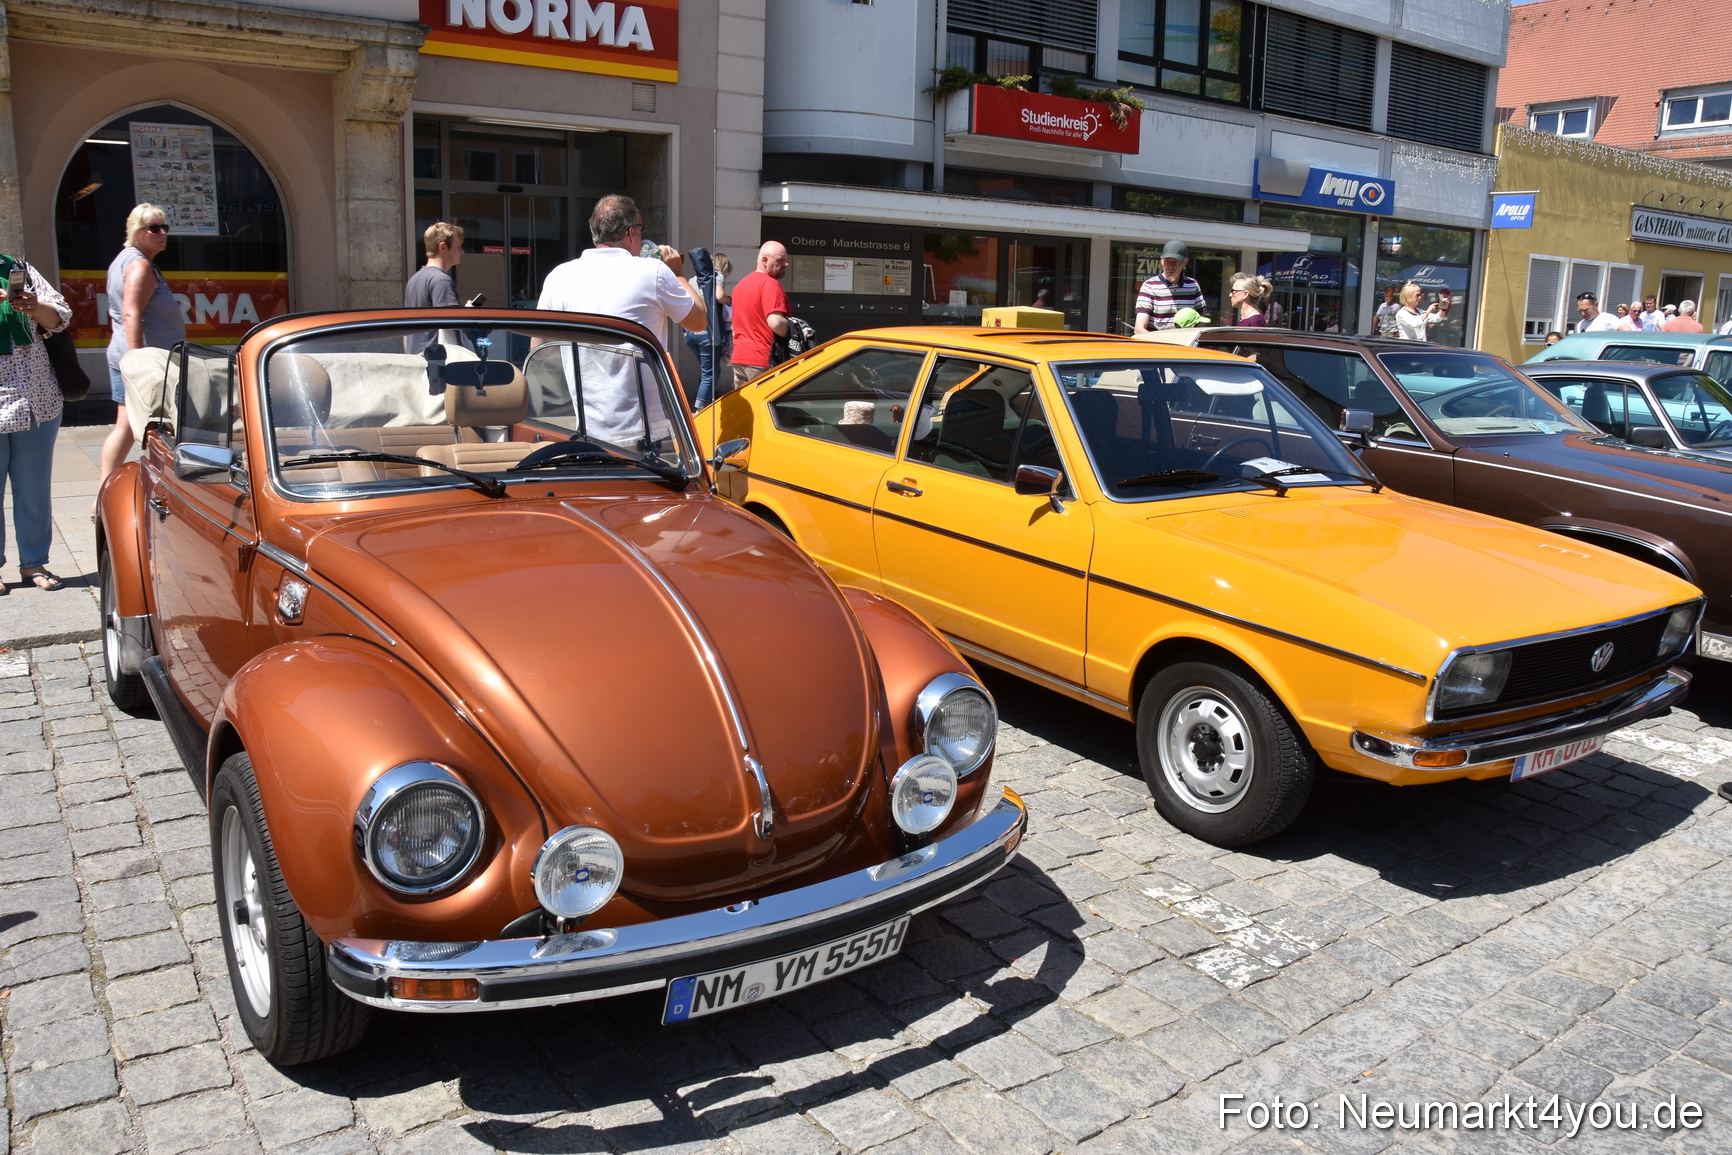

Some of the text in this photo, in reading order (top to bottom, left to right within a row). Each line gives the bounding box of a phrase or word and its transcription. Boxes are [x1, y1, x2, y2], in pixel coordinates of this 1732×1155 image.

[446, 0, 654, 51] NORMA
[133, 125, 162, 134] NORMA
[1021, 108, 1089, 131] Studienkreis
[1029, 125, 1065, 136] Profi-Nachhilfe
[1319, 172, 1359, 199] APOLLO
[1337, 197, 1355, 207] OPTIK
[1495, 203, 1530, 216] APOLLO
[1634, 214, 1686, 238] GASTHAUS
[791, 236, 910, 250] Obere Marktstrasse 9
[97, 293, 260, 325] RMA
[674, 920, 907, 1015] D NM YM 555H
